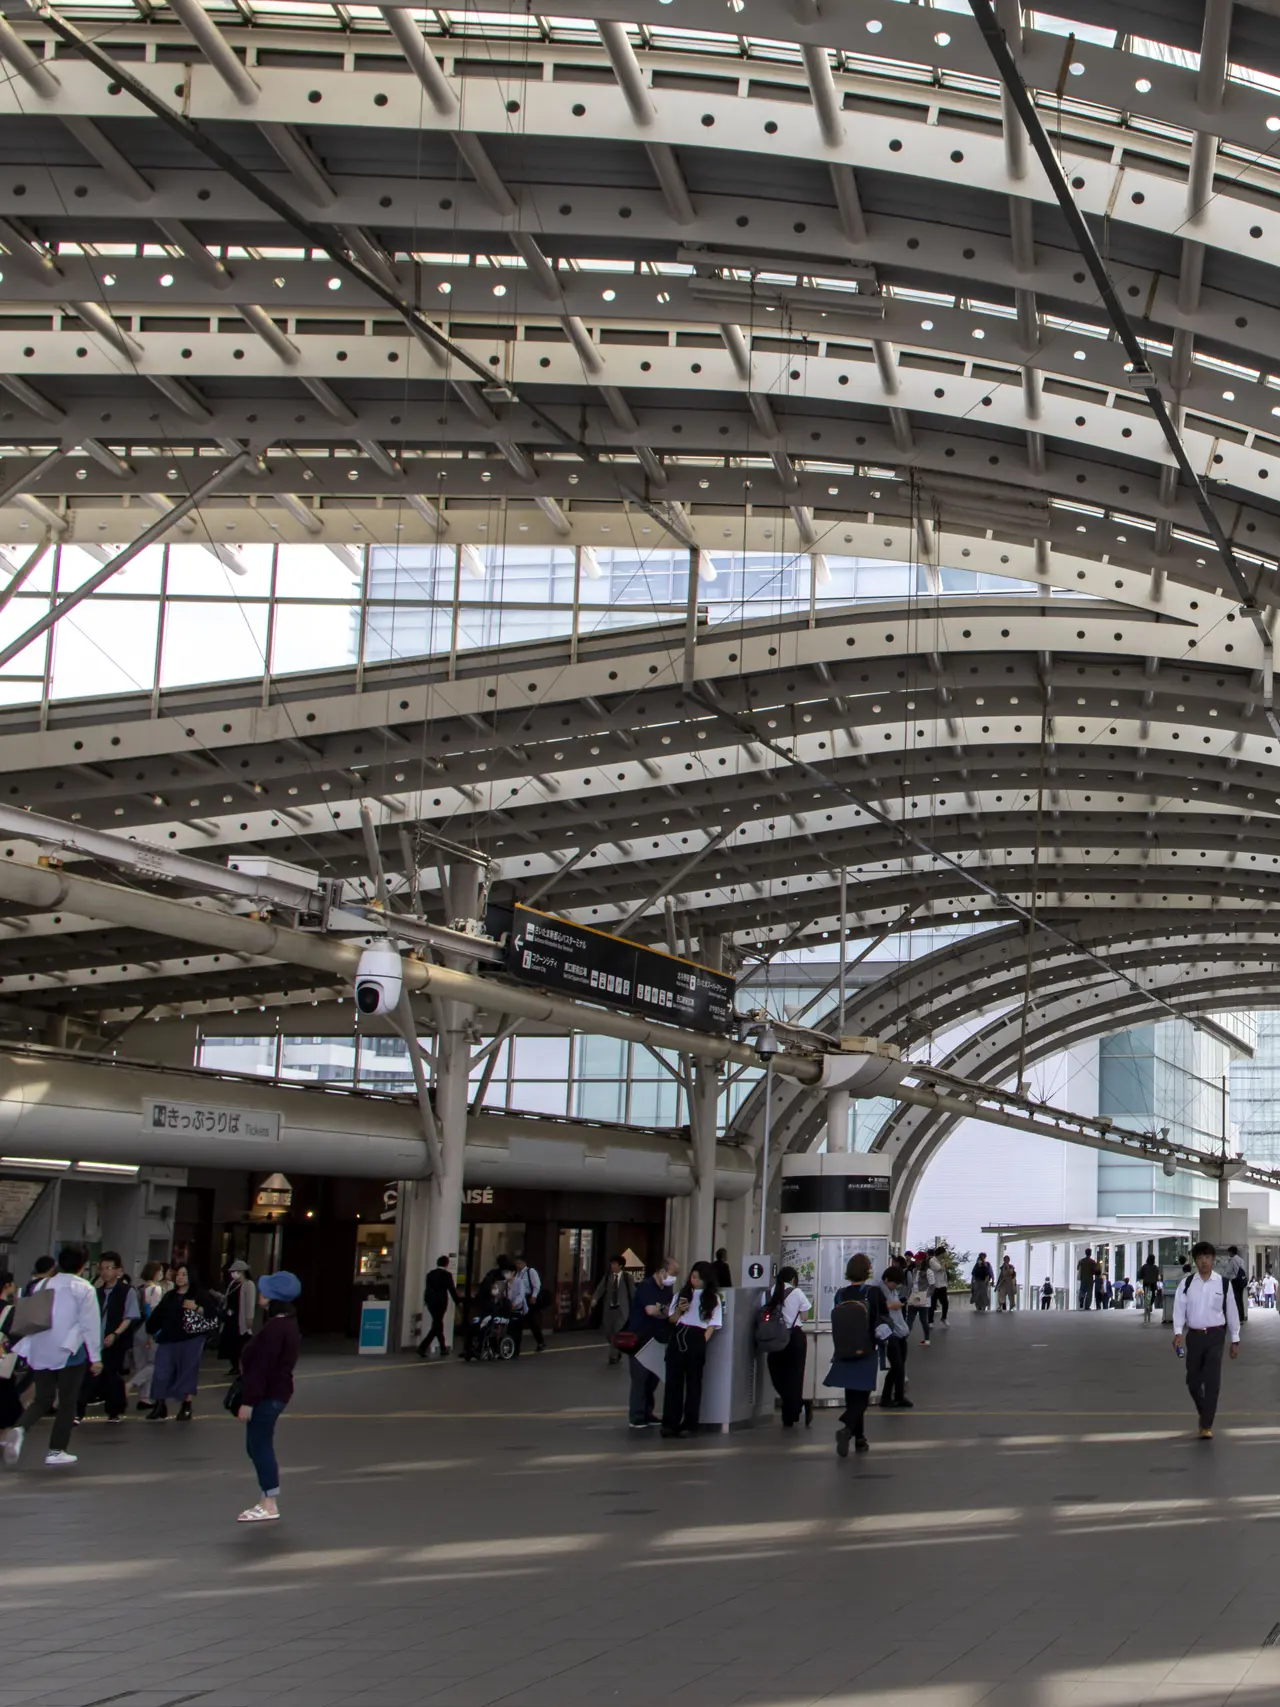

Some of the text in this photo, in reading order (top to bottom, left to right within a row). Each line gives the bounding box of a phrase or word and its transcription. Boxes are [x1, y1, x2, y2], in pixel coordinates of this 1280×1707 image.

[167, 1107, 269, 1137] きっぷうりば Tickets
